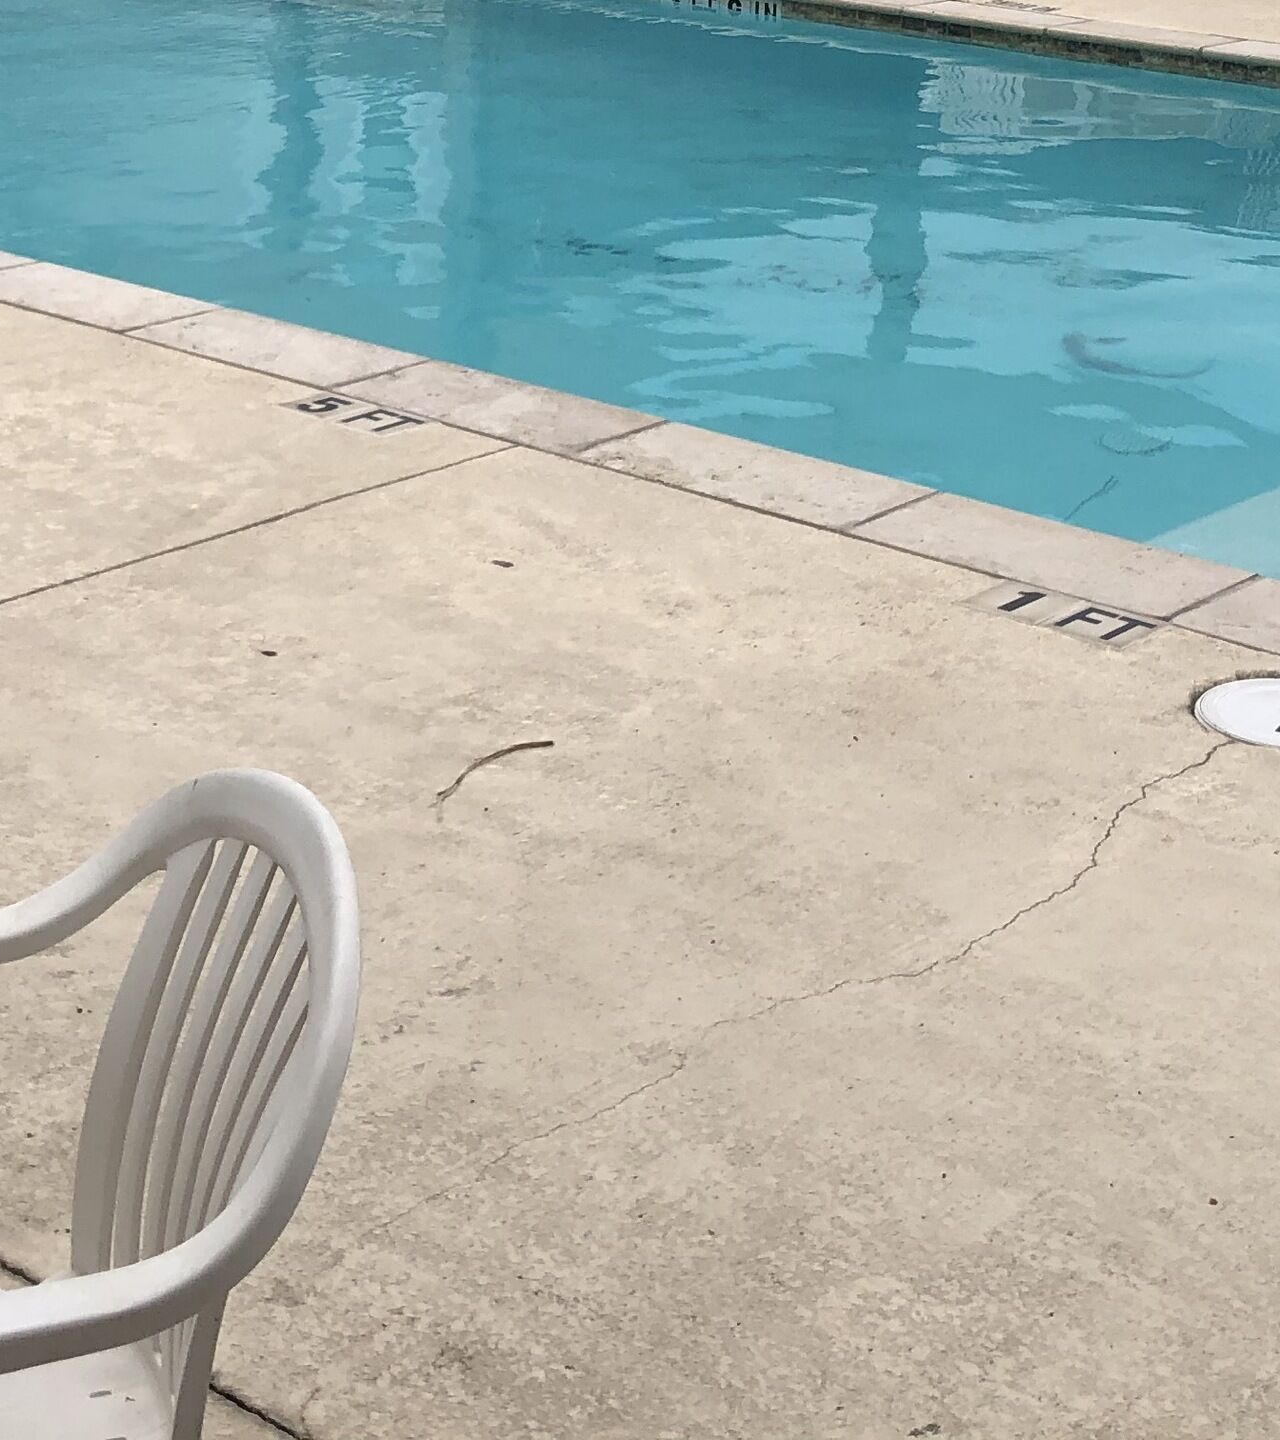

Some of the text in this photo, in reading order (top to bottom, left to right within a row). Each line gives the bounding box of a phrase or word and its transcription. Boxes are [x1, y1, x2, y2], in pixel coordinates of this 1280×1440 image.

[754, 0, 778, 17] IN
[297, 396, 425, 432] 5 FT
[997, 590, 1158, 641] 1 FT
